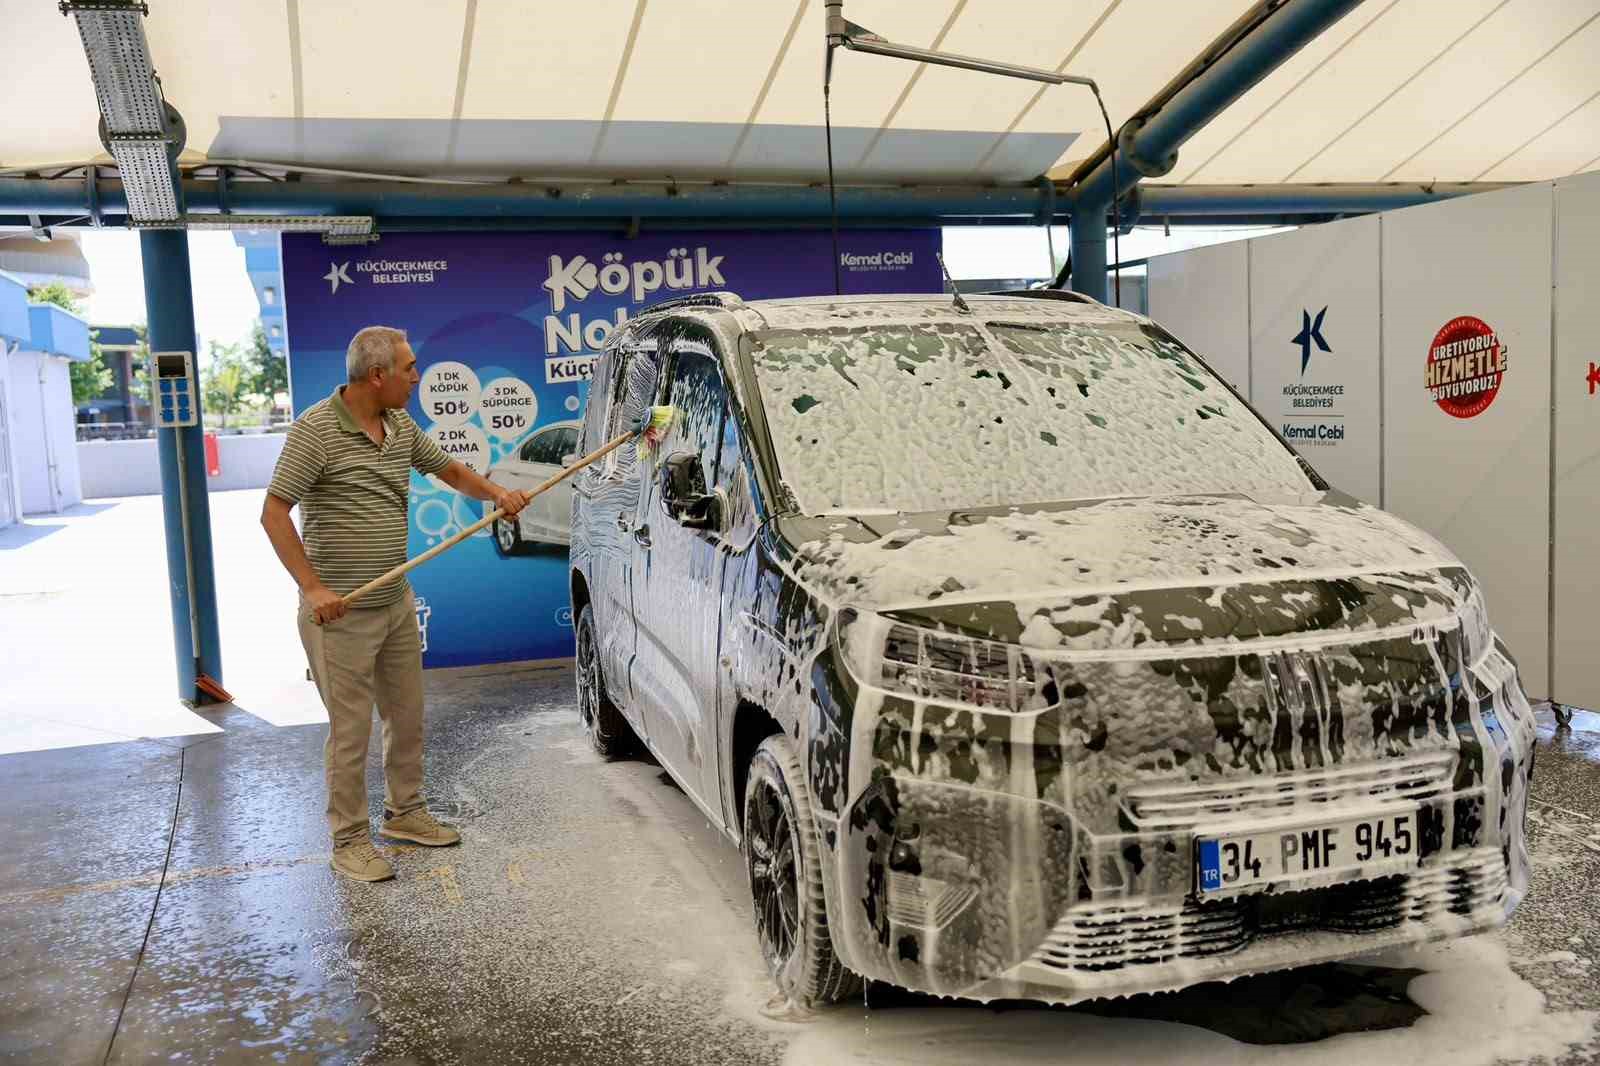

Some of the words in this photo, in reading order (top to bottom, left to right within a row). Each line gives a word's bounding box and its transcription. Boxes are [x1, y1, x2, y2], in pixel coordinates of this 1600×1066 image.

[841, 252, 882, 266] Kemal
[356, 260, 448, 273] KÜÇÜKÇEKMECE
[373, 271, 434, 284] BELEDİYESİ
[542, 247, 726, 313] Köpük
[1433, 333, 1498, 361] ÜRETİYORUZ
[1424, 344, 1507, 388] HİZMETLE
[436, 373, 441, 381] 1
[444, 372, 460, 381] DK
[430, 383, 469, 393] KÖPÜK
[494, 388, 501, 396] 3
[503, 387, 518, 395] DK
[1283, 384, 1344, 396] KÜÇÜKÇEKMECE
[482, 397, 533, 408] SÜPÜRGE
[1292, 396, 1334, 408] BELEDİYESİ
[439, 431, 447, 440] 2
[449, 430, 467, 440] DK
[1283, 424, 1316, 438] Kemal
[441, 443, 480, 454] KAMA
[1222, 839, 1261, 883] 34
[1280, 828, 1339, 874] PMF
[1355, 816, 1412, 861] 945
[1203, 869, 1218, 881] TR
